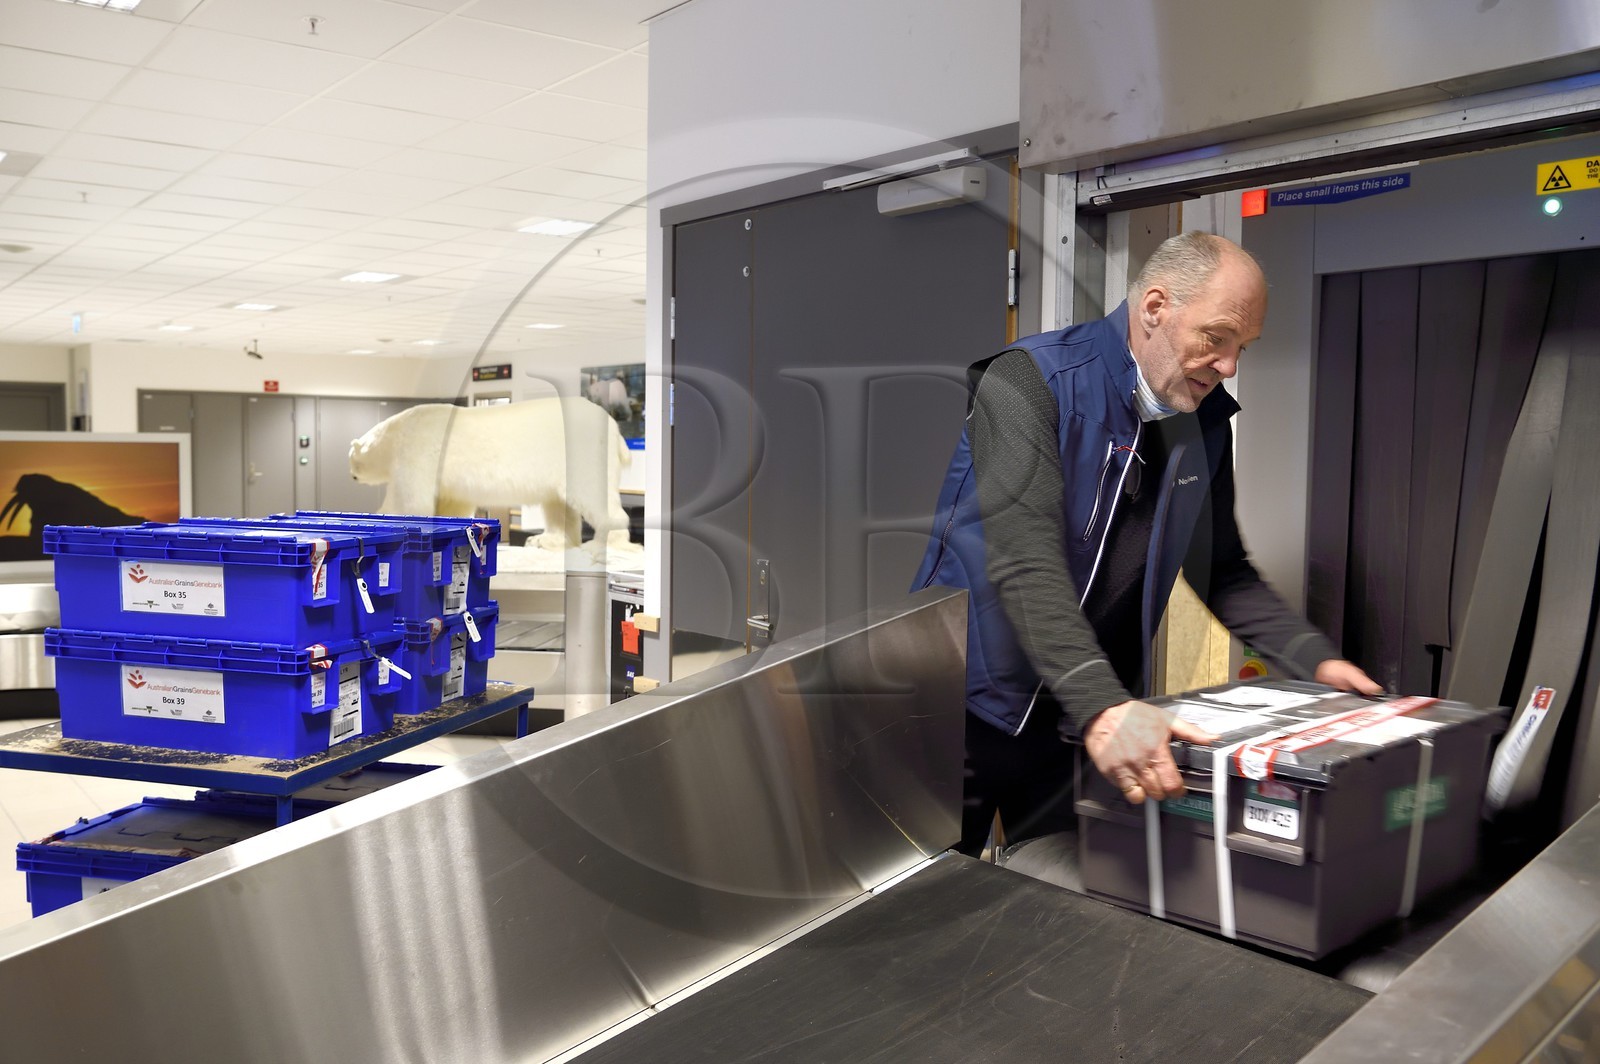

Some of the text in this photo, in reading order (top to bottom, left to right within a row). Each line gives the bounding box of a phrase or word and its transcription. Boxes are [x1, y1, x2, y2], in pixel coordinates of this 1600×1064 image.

[1277, 176, 1404, 202] Place small items this side
[163, 590, 187, 599] Box 35
[162, 696, 186, 705] Box 39
